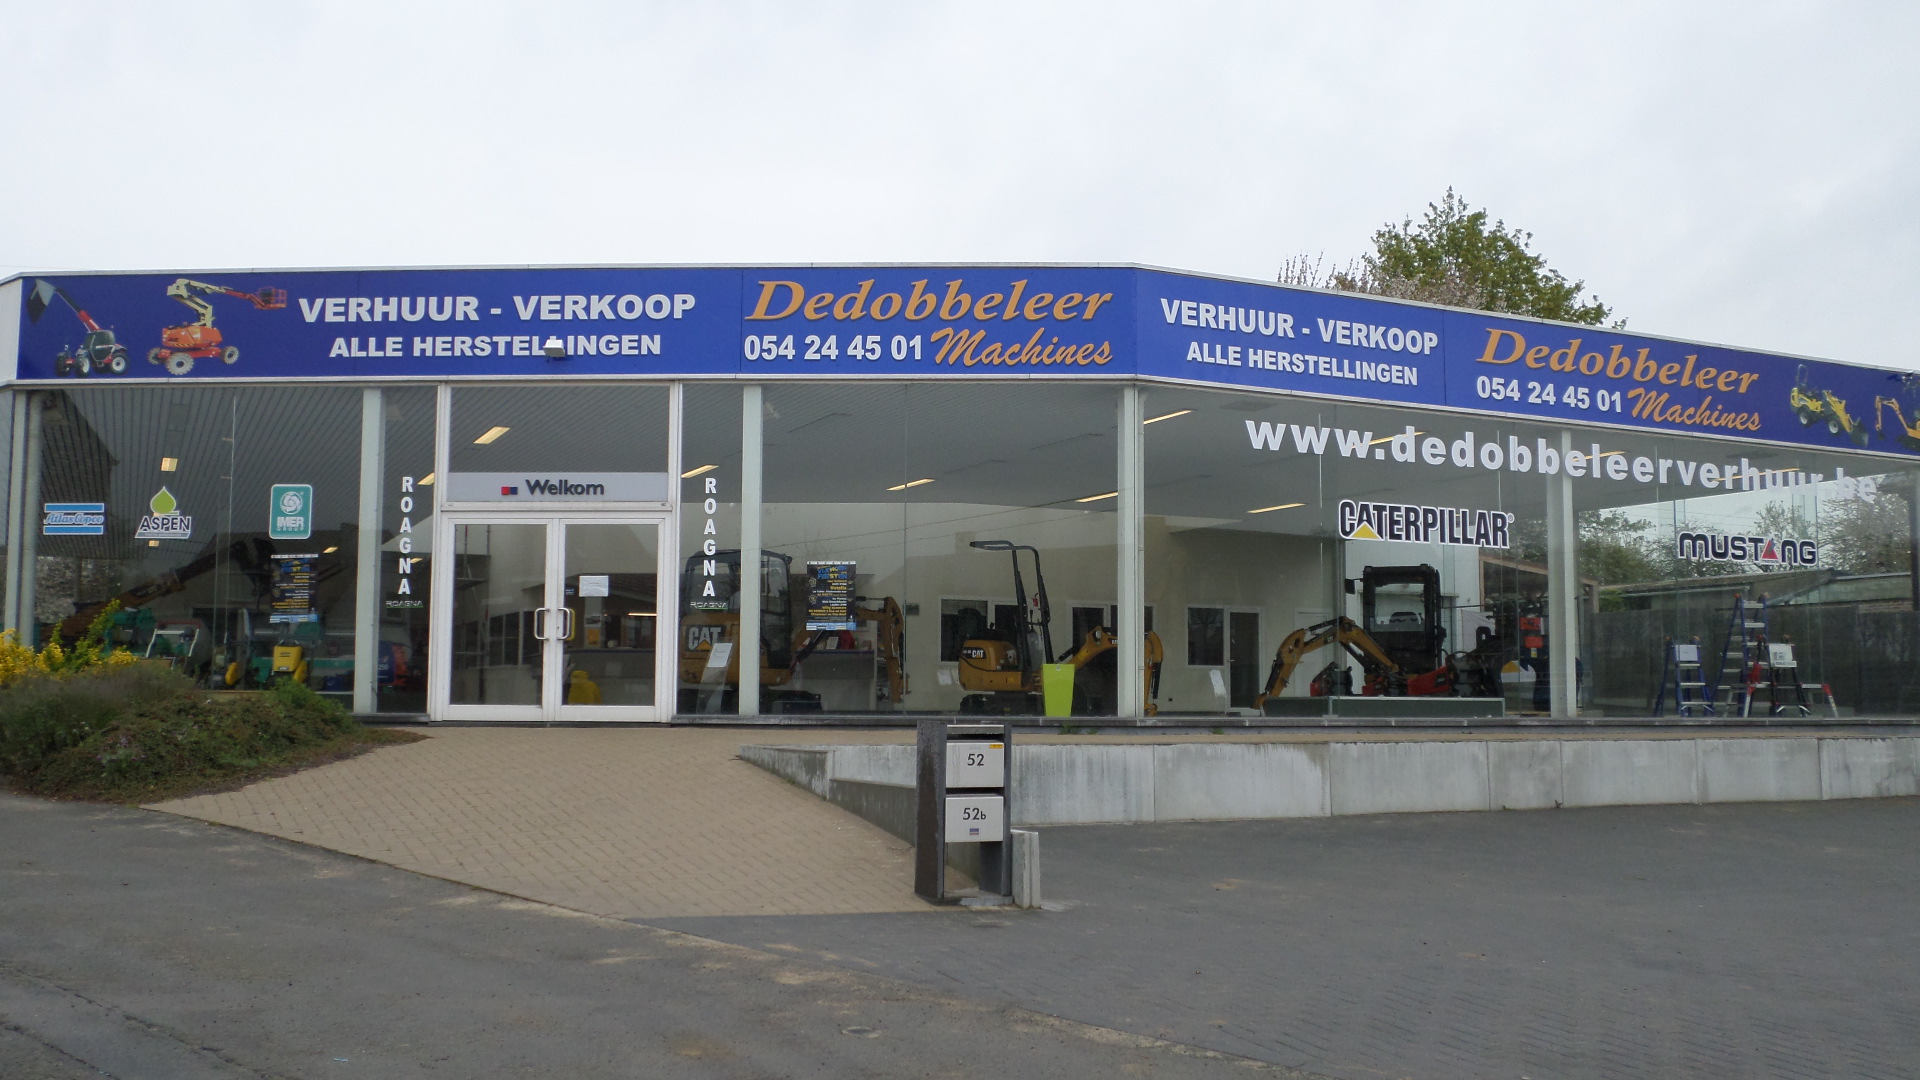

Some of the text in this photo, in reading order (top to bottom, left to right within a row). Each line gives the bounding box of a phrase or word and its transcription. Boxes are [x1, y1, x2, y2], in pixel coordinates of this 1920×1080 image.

[298, 293, 697, 324] VERHUUR - VERKOOP
[746, 279, 1113, 322] Dedobbeleer
[1160, 297, 1439, 356] VERHUUR - VERKOOP
[329, 334, 661, 359] ALLE HERSTELINGEN
[744, 334, 922, 361] 054 24 45 01
[930, 327, 1113, 367] Machines
[1186, 341, 1419, 386] ALLE HERSTELLINGEN
[1476, 328, 1760, 392] Dedobbeleer
[1476, 375, 1624, 414] 054 24 45 01
[1627, 387, 1760, 431] Machines
[1245, 419, 1878, 504] www.dedobbeleerverhuur.be
[525, 479, 605, 496] Welkom
[139, 516, 191, 532] ASPEN
[277, 516, 304, 528] IMER
[397, 476, 414, 595] ROAGNA
[702, 477, 717, 597] ROAGNA
[1679, 532, 1817, 566] MUSTANG
[688, 627, 722, 651] CAT
[972, 650, 984, 659] CAT
[967, 753, 985, 767] 52
[962, 807, 987, 821] 52b
